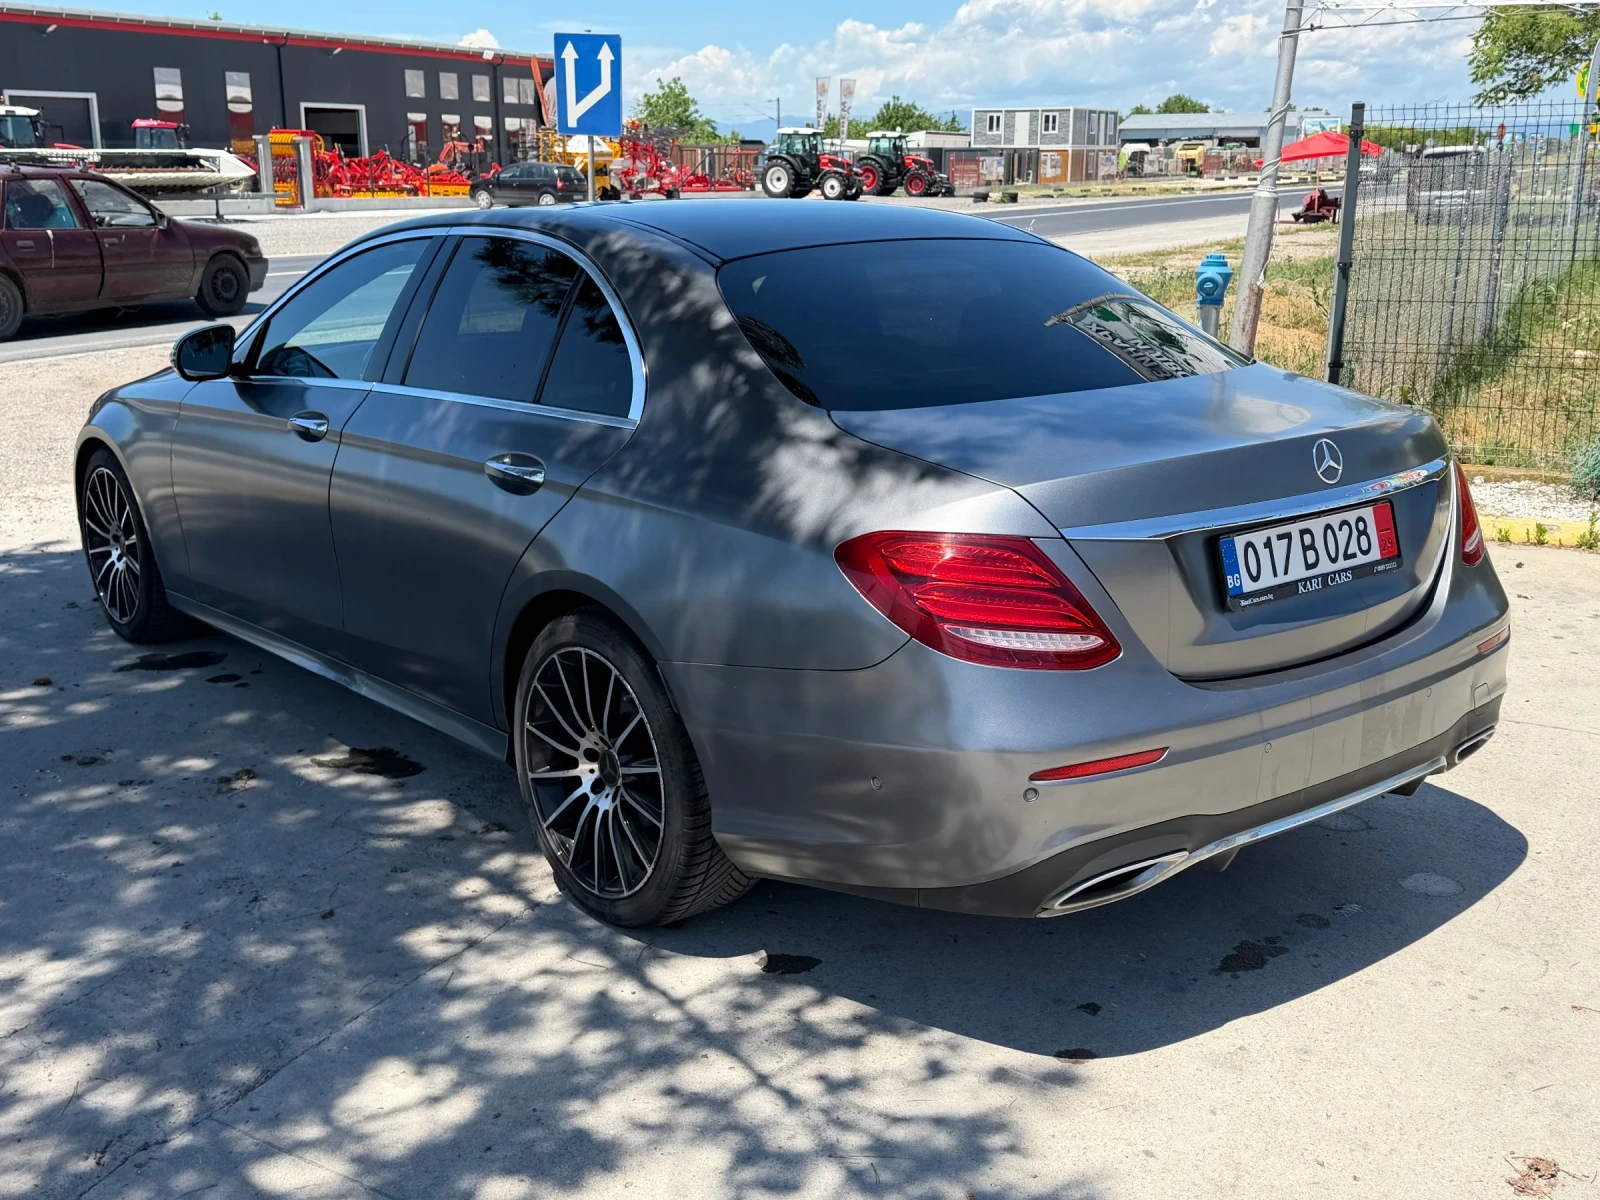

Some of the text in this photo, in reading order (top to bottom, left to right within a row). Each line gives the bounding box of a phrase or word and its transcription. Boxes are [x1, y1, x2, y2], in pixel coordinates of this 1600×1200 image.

[1381, 537, 1393, 553] 29
[1227, 574, 1241, 588] BG
[1298, 570, 1353, 594] KARI CARS
